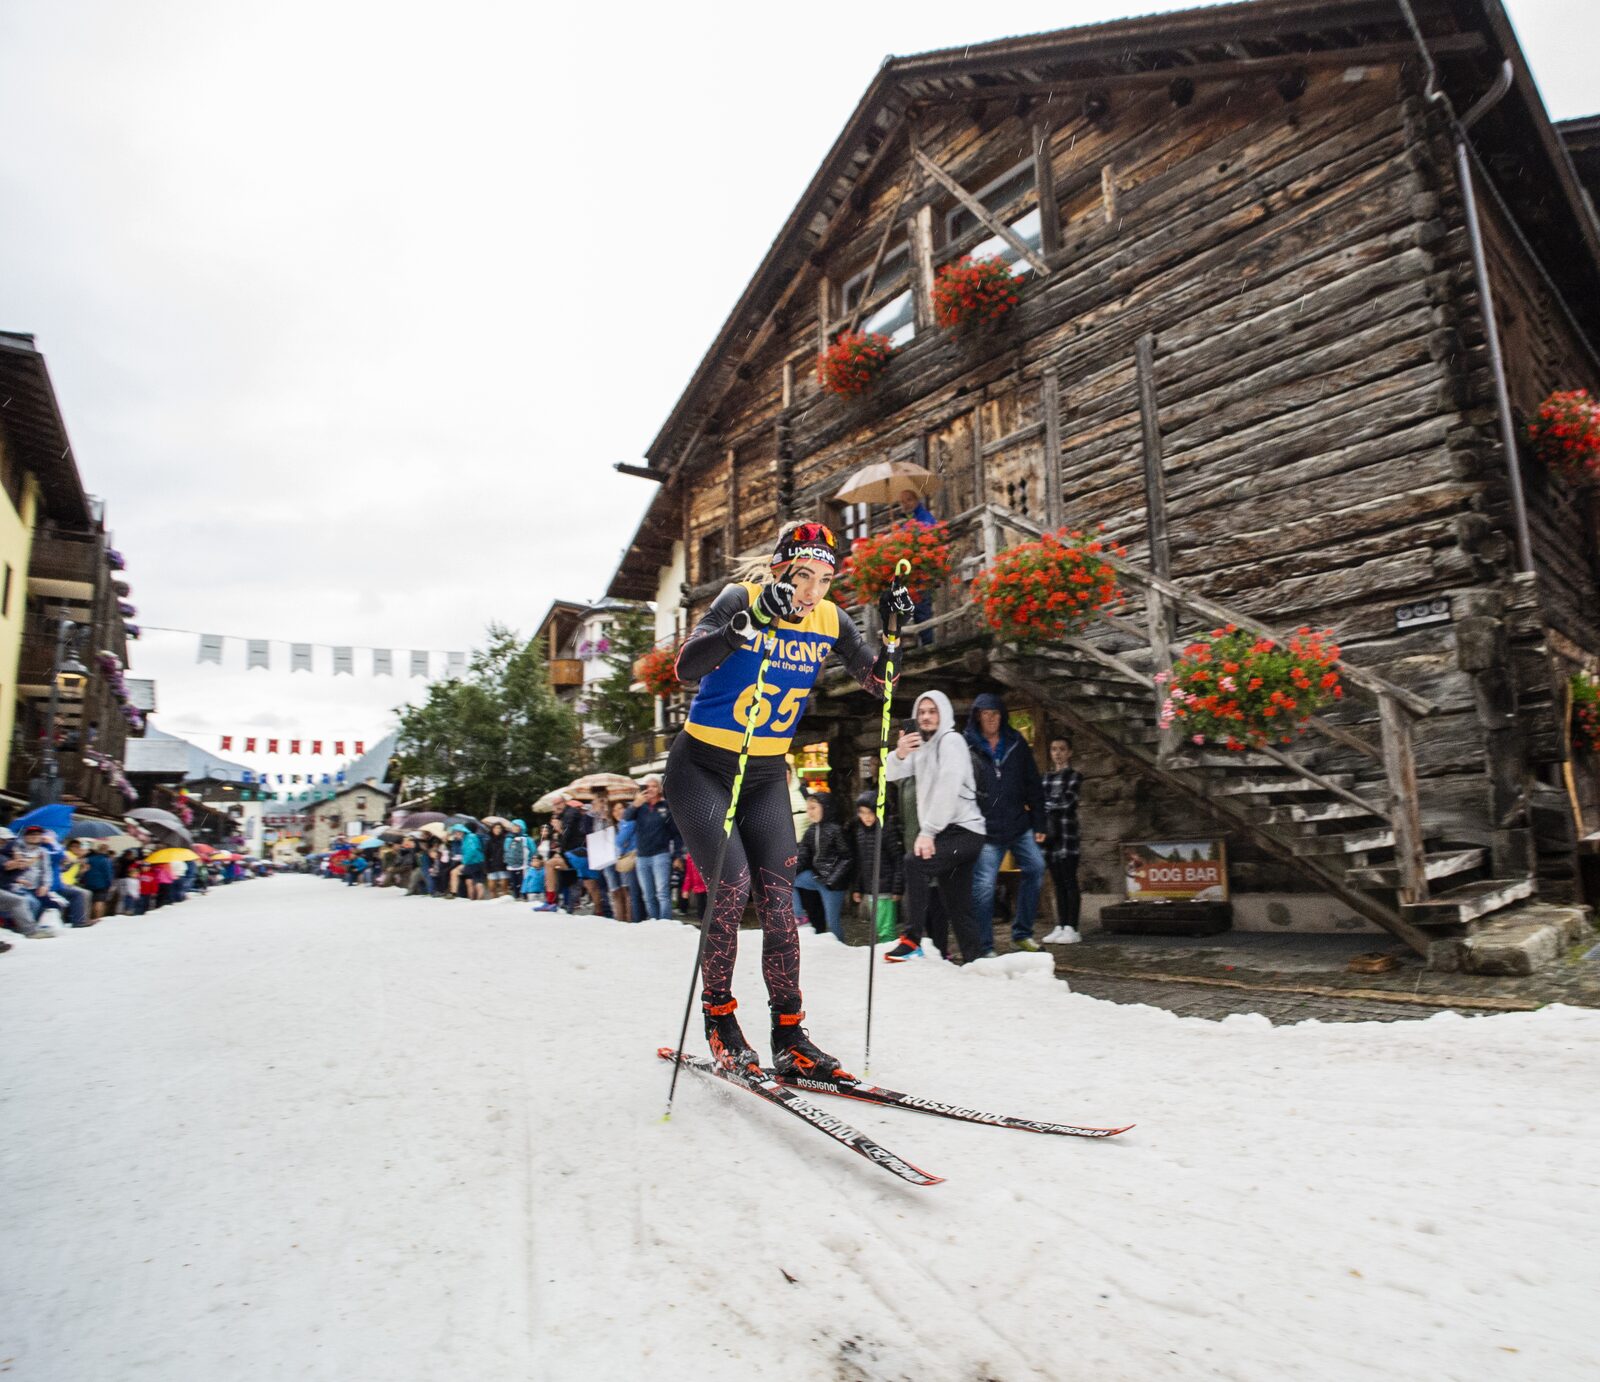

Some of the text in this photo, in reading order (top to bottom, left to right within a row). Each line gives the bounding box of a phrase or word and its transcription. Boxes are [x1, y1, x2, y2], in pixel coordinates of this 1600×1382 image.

[782, 661, 797, 671] the
[798, 664, 814, 674] alps
[733, 683, 811, 733] 65
[1148, 867, 1217, 881] DOG BAR
[797, 1078, 840, 1093] ROSSIGNOL
[784, 1096, 859, 1146] ROSSIGNOL
[899, 1094, 1011, 1126] ROSSIGNOL
